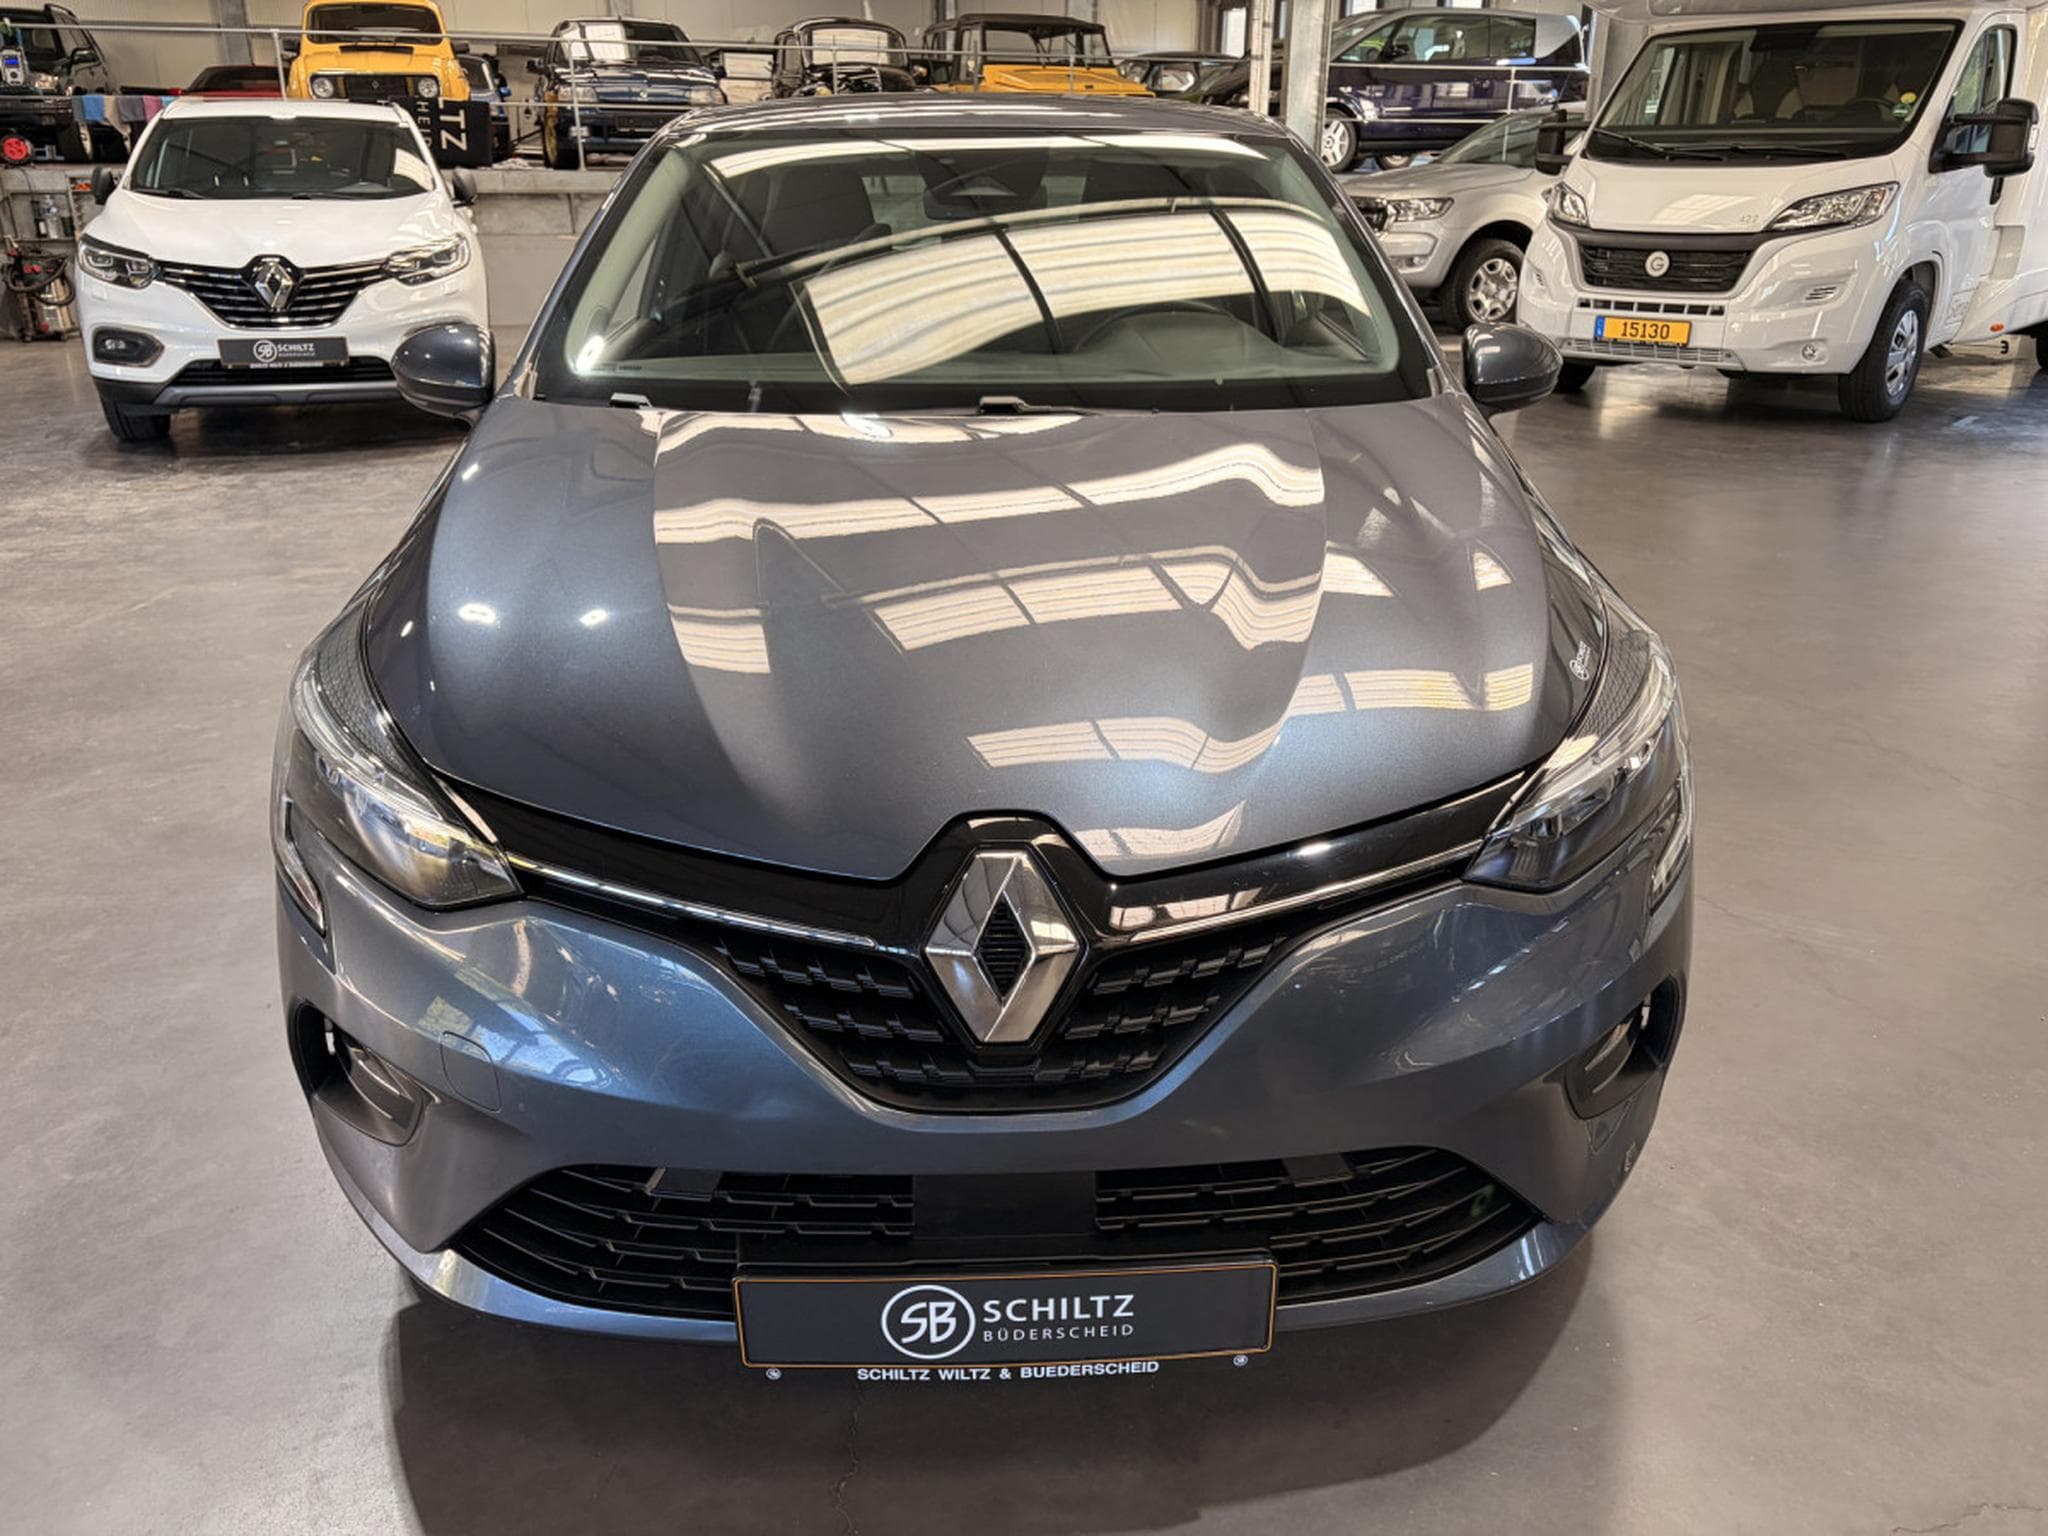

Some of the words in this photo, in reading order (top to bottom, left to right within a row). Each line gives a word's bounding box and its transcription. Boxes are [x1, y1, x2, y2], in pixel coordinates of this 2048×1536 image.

[1620, 321, 1670, 340] 15130
[277, 342, 315, 352] SCHILTZ
[983, 1294, 1135, 1323] SCHILTZ
[900, 1301, 957, 1344] SB
[983, 1324, 1135, 1342] BÜDERSCHEID
[856, 1367, 931, 1381] SCHILTZ
[938, 1367, 991, 1381] WILTZ
[999, 1367, 1012, 1380] &
[1019, 1360, 1160, 1379] BUEDERSCHEID
